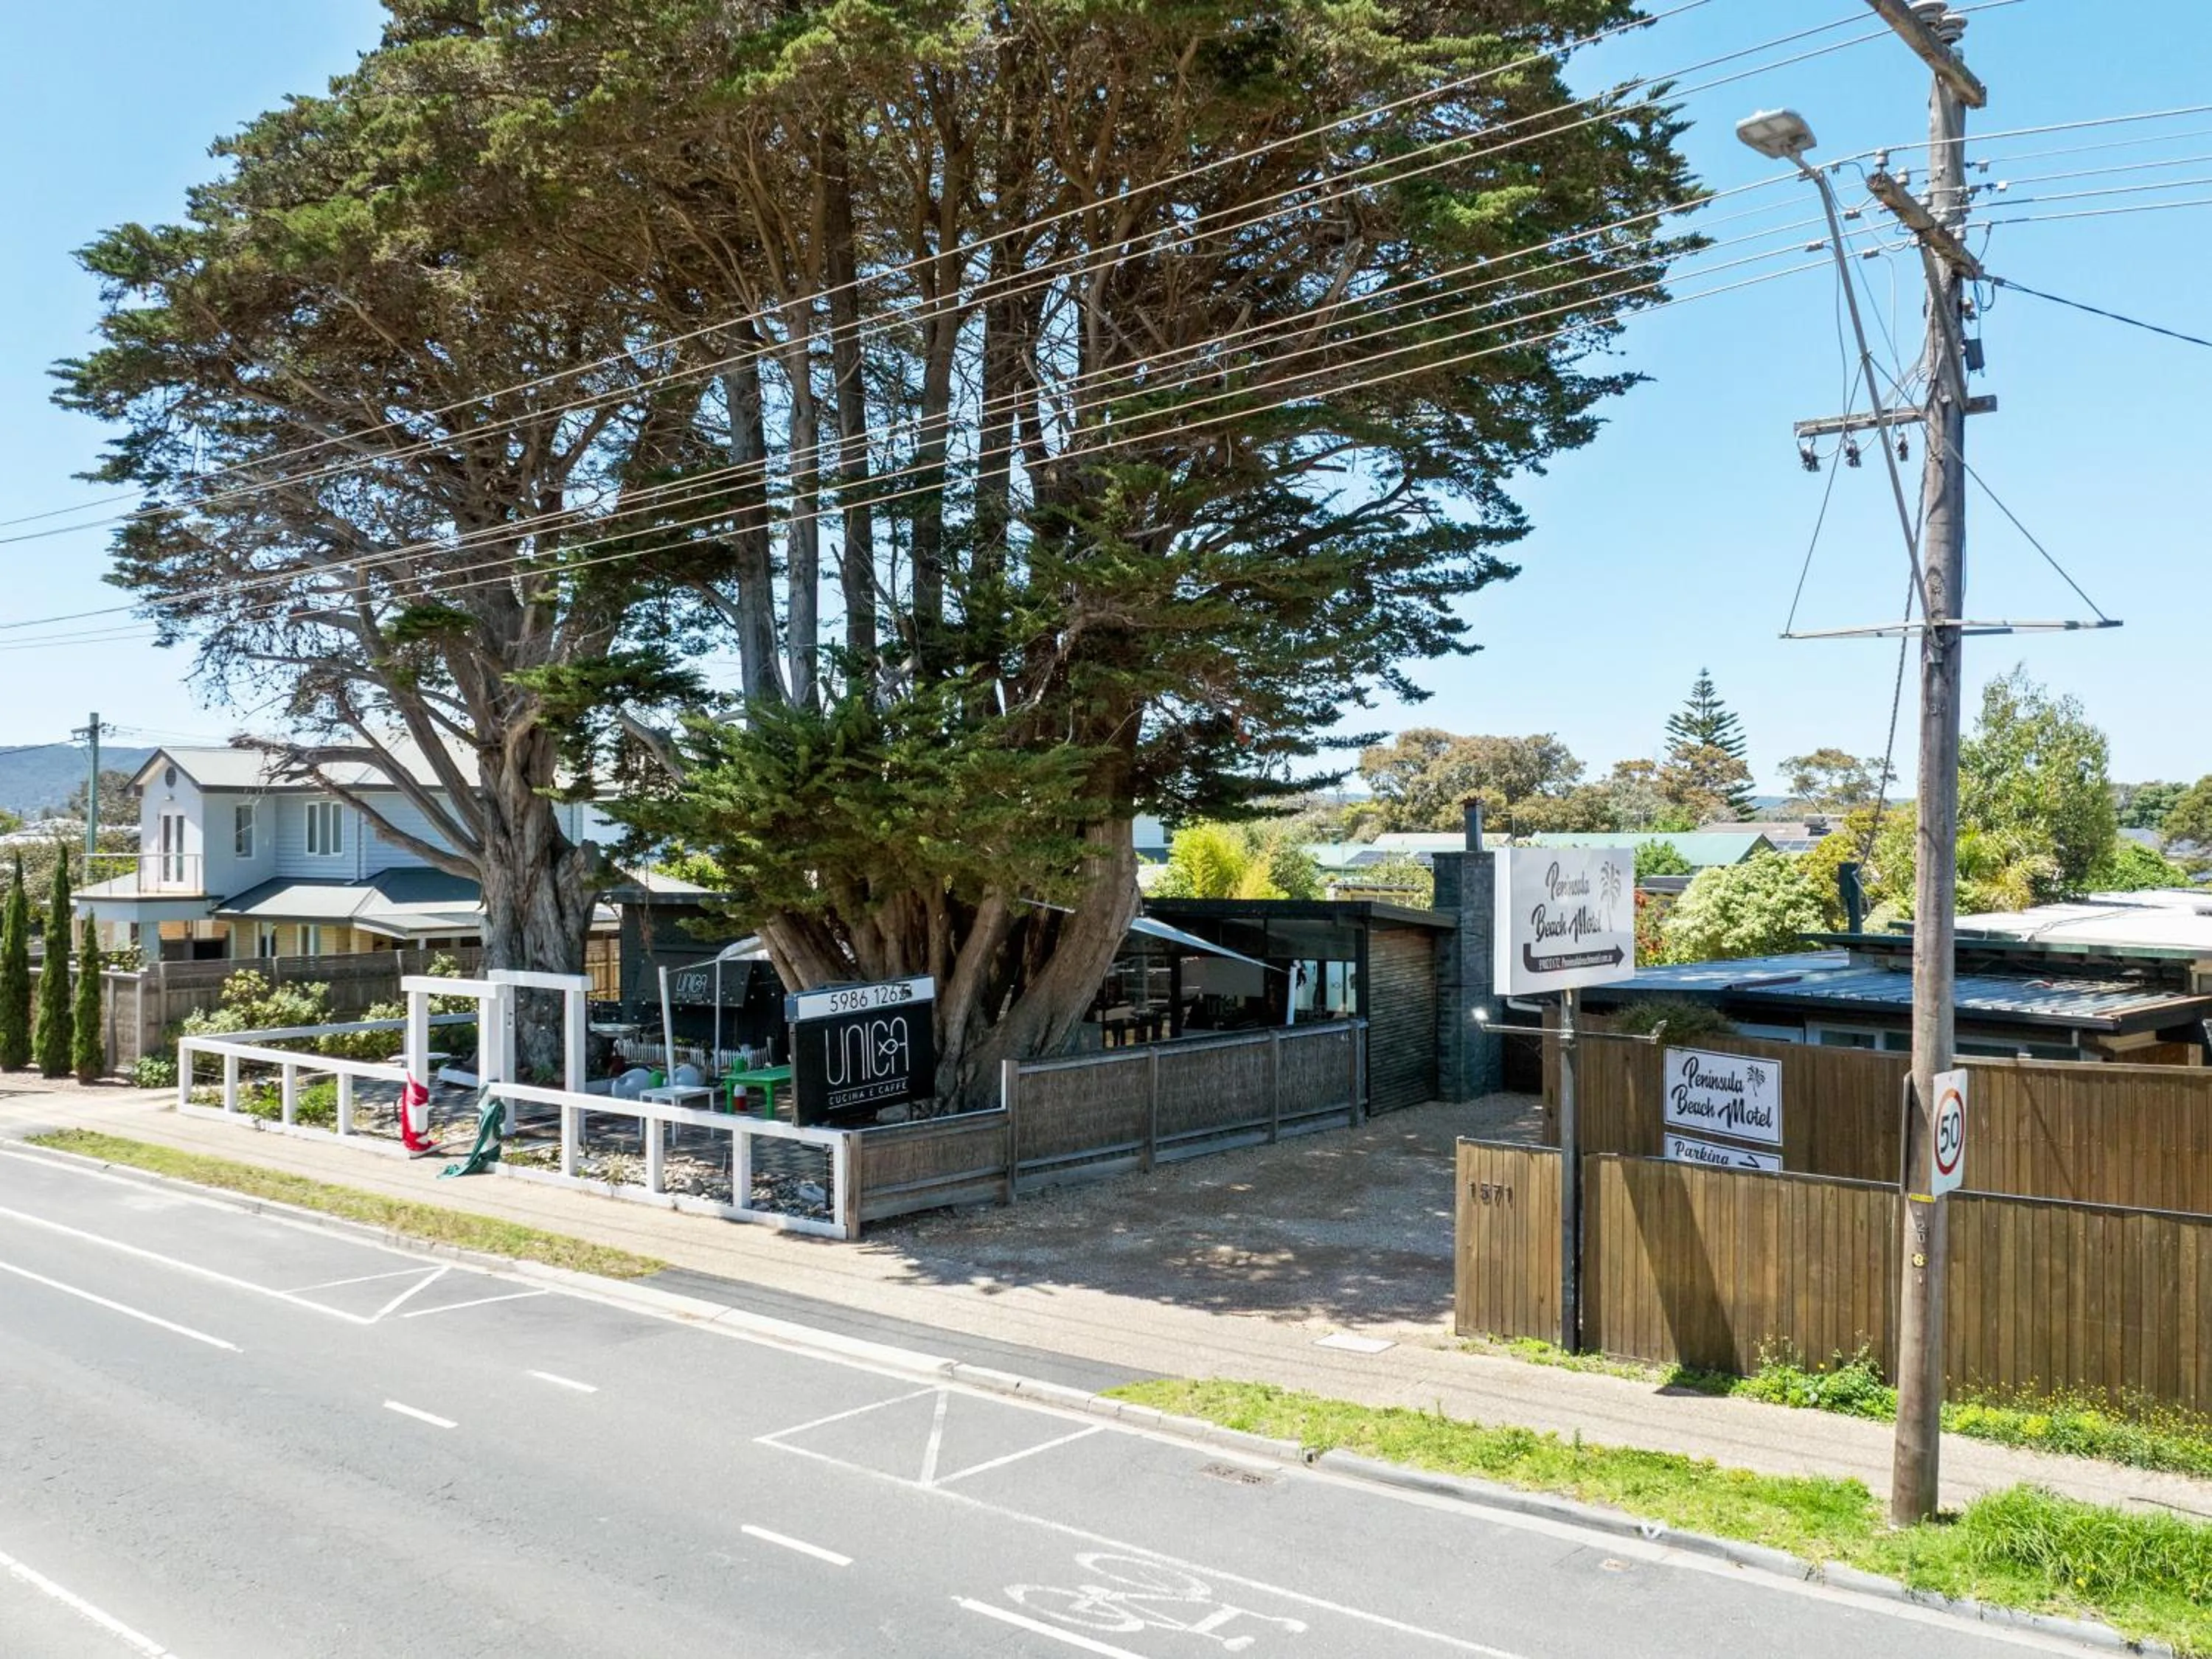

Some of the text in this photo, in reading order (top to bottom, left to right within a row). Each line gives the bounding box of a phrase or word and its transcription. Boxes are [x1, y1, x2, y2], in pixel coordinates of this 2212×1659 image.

[1545, 860, 1590, 901] Peninsula
[1531, 903, 1601, 944] Beach Motel
[830, 990, 868, 1012] 5986
[825, 1016, 909, 1085] UNICA
[1682, 1056, 1745, 1093] Peninsula
[827, 1091, 865, 1105] CUCINA
[1671, 1083, 1773, 1129] Beach Motel
[1939, 1112, 1960, 1154] 50
[1467, 1180, 1514, 1209] 1571
